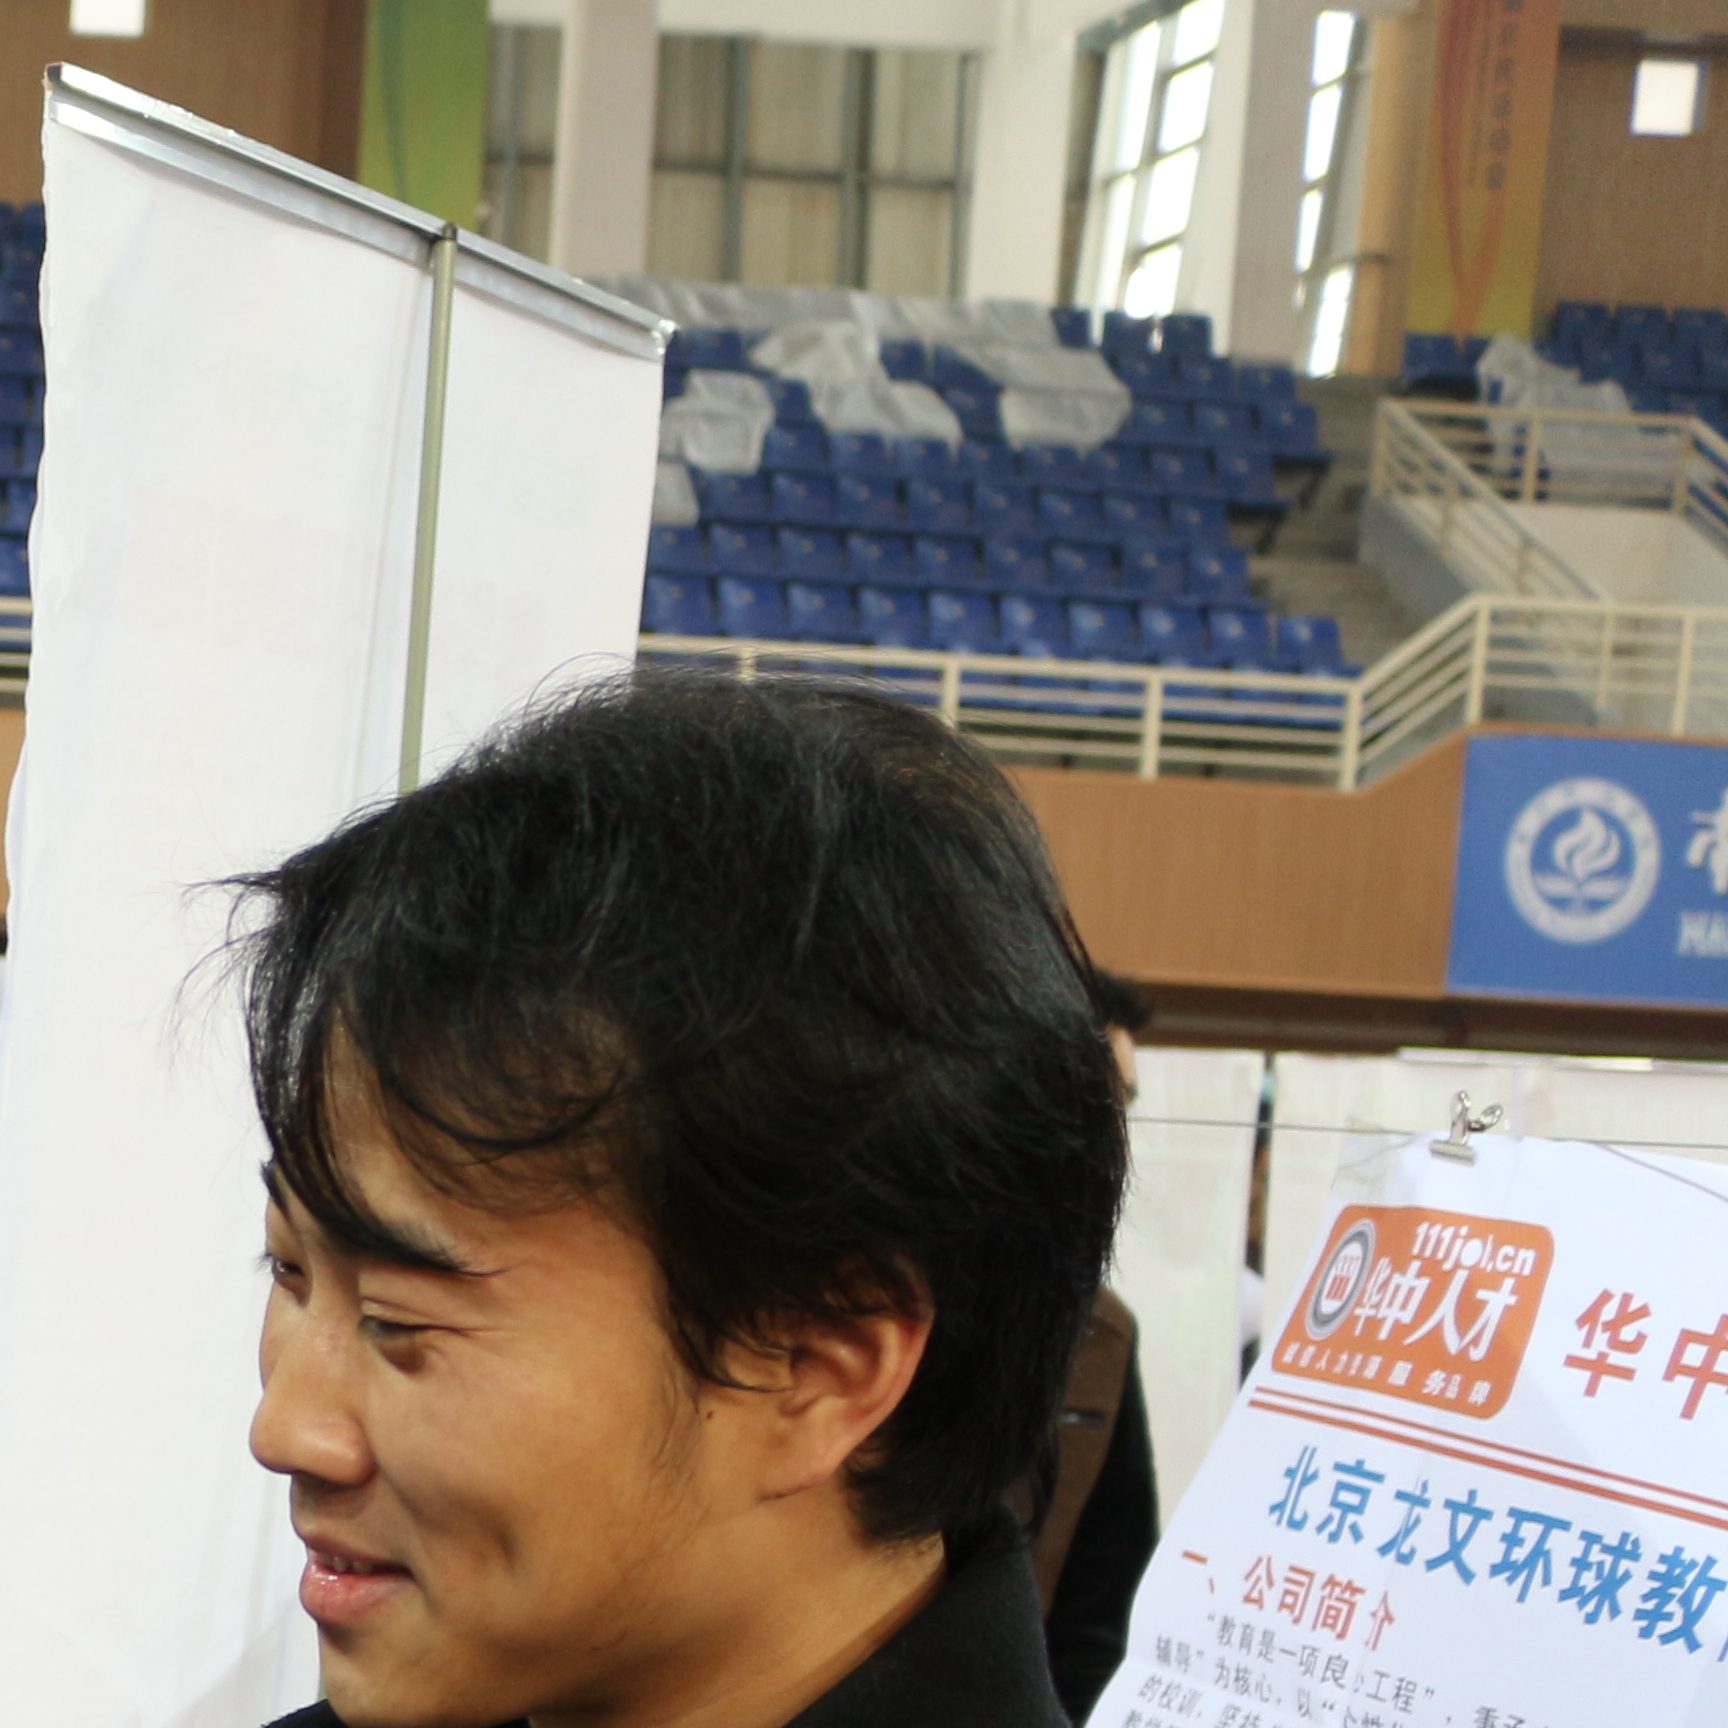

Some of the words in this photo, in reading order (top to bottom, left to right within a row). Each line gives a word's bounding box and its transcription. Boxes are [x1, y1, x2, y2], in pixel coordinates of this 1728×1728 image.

[1353, 1256, 1519, 1362] 华中人才
[1563, 1288, 1728, 1421] 华中
[1268, 1445, 1728, 1662] 北京龙文环球教
